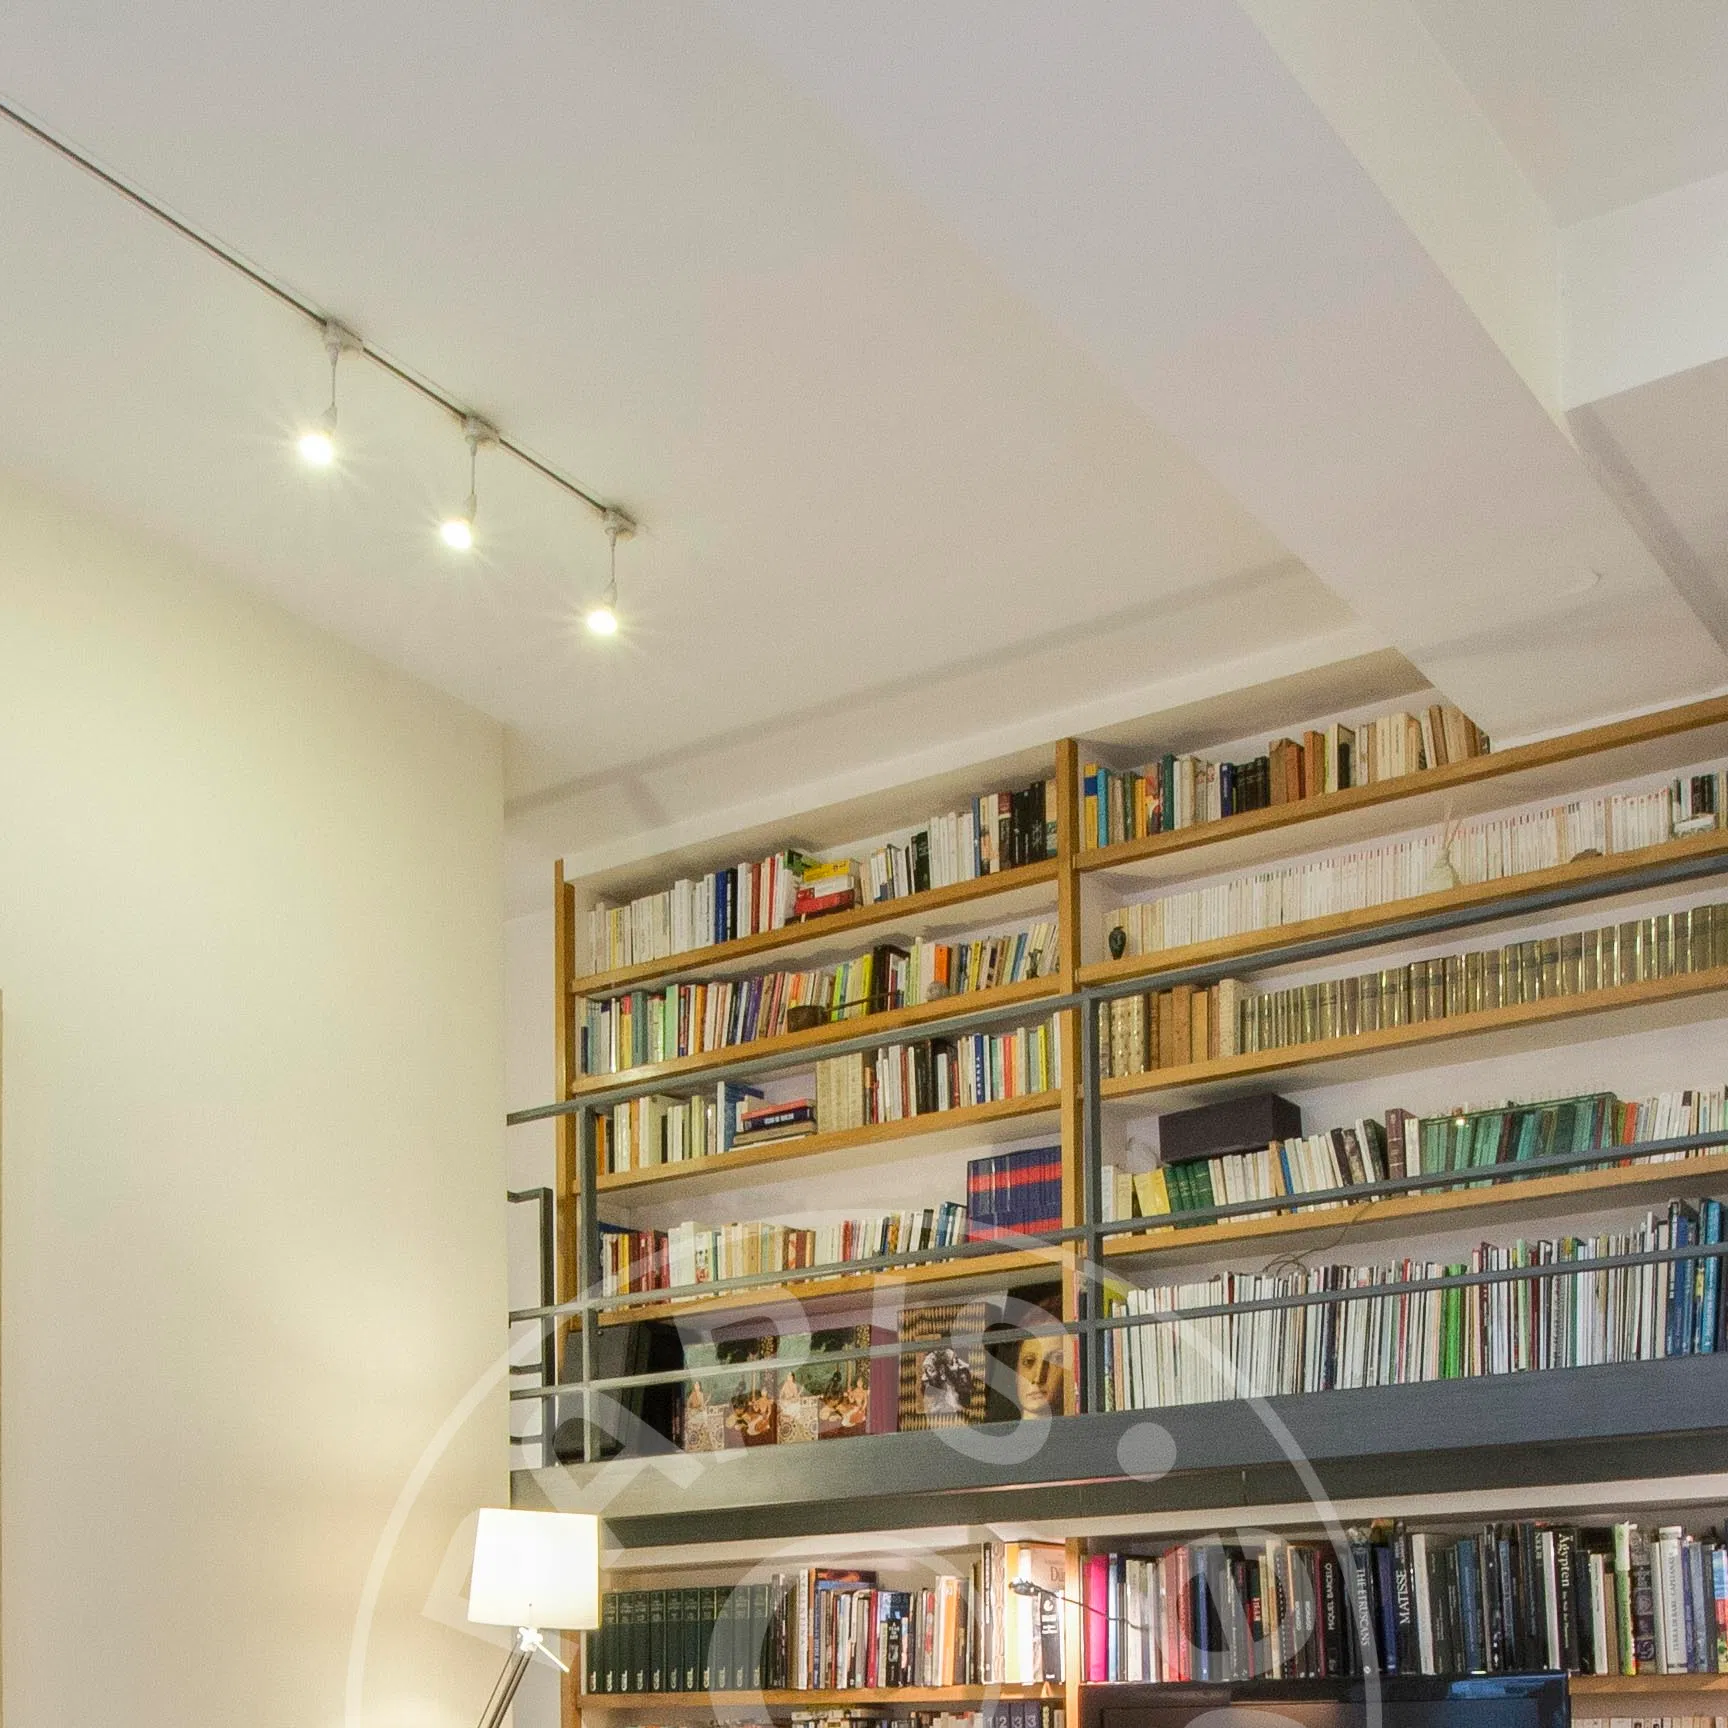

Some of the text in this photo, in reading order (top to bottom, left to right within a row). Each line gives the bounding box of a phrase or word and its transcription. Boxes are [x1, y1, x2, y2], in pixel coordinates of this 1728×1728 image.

[1554, 1533, 1573, 1588] Ägypten
[1324, 1563, 1335, 1631] MIQUEL BARCELÓ
[1356, 1568, 1370, 1647] THE ETRUSCANS
[1395, 1569, 1411, 1624] MATISSE
[987, 1715, 996, 1728] 1
[1026, 1714, 1037, 1728] 3
